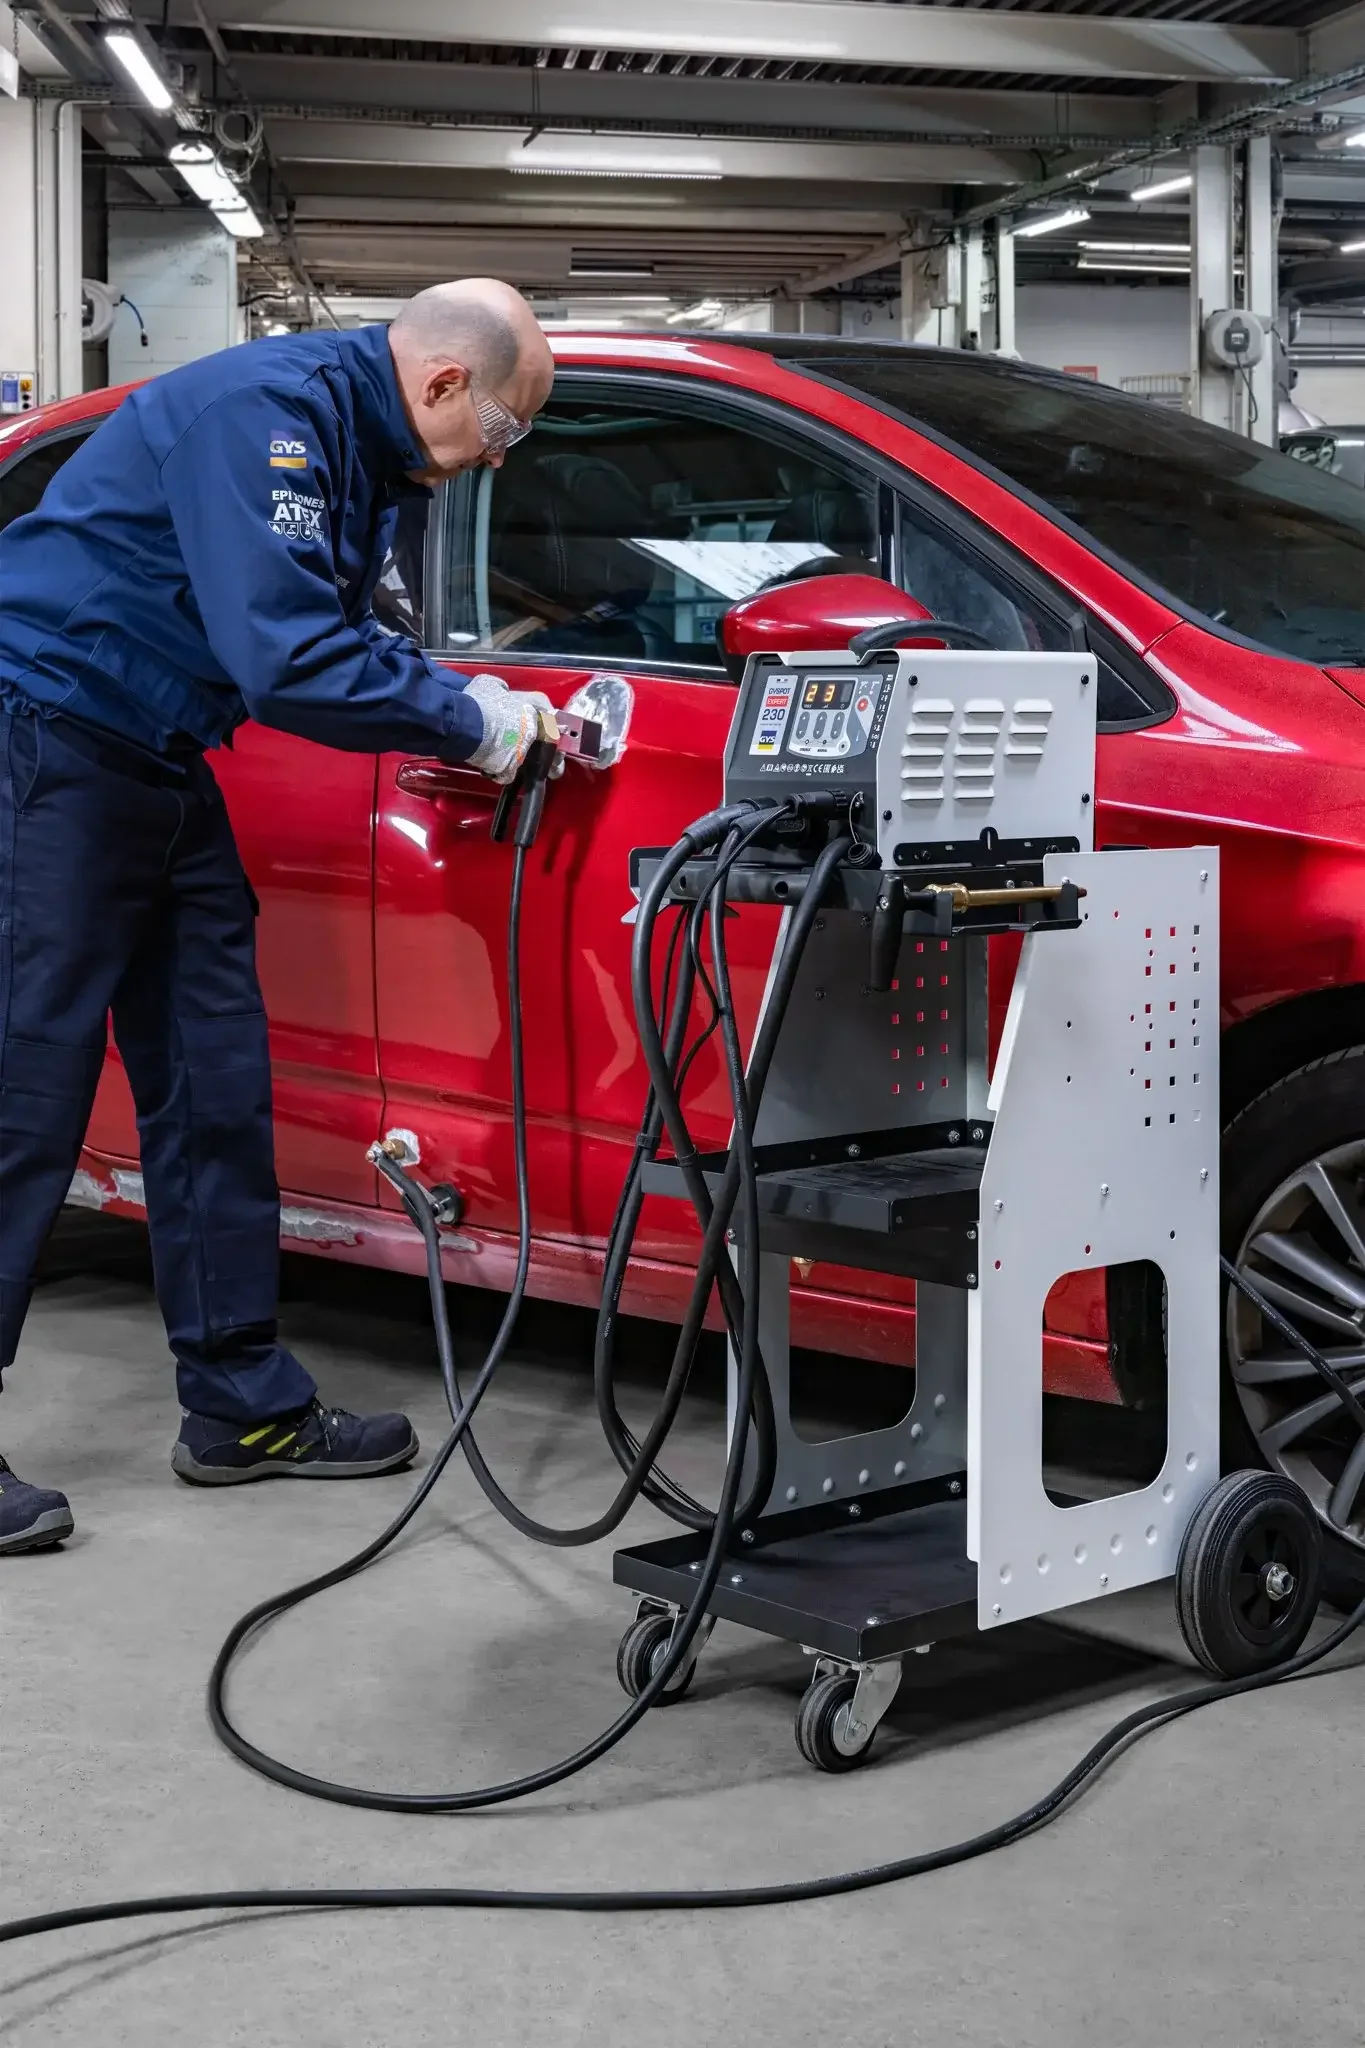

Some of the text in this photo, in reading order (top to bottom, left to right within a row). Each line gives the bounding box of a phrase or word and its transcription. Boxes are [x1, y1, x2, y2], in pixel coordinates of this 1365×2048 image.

[270, 440, 306, 454] GYS
[272, 490, 292, 501] EPI
[273, 503, 322, 529] ATEX
[805, 684, 835, 702] 2 3
[762, 709, 785, 720] 230
